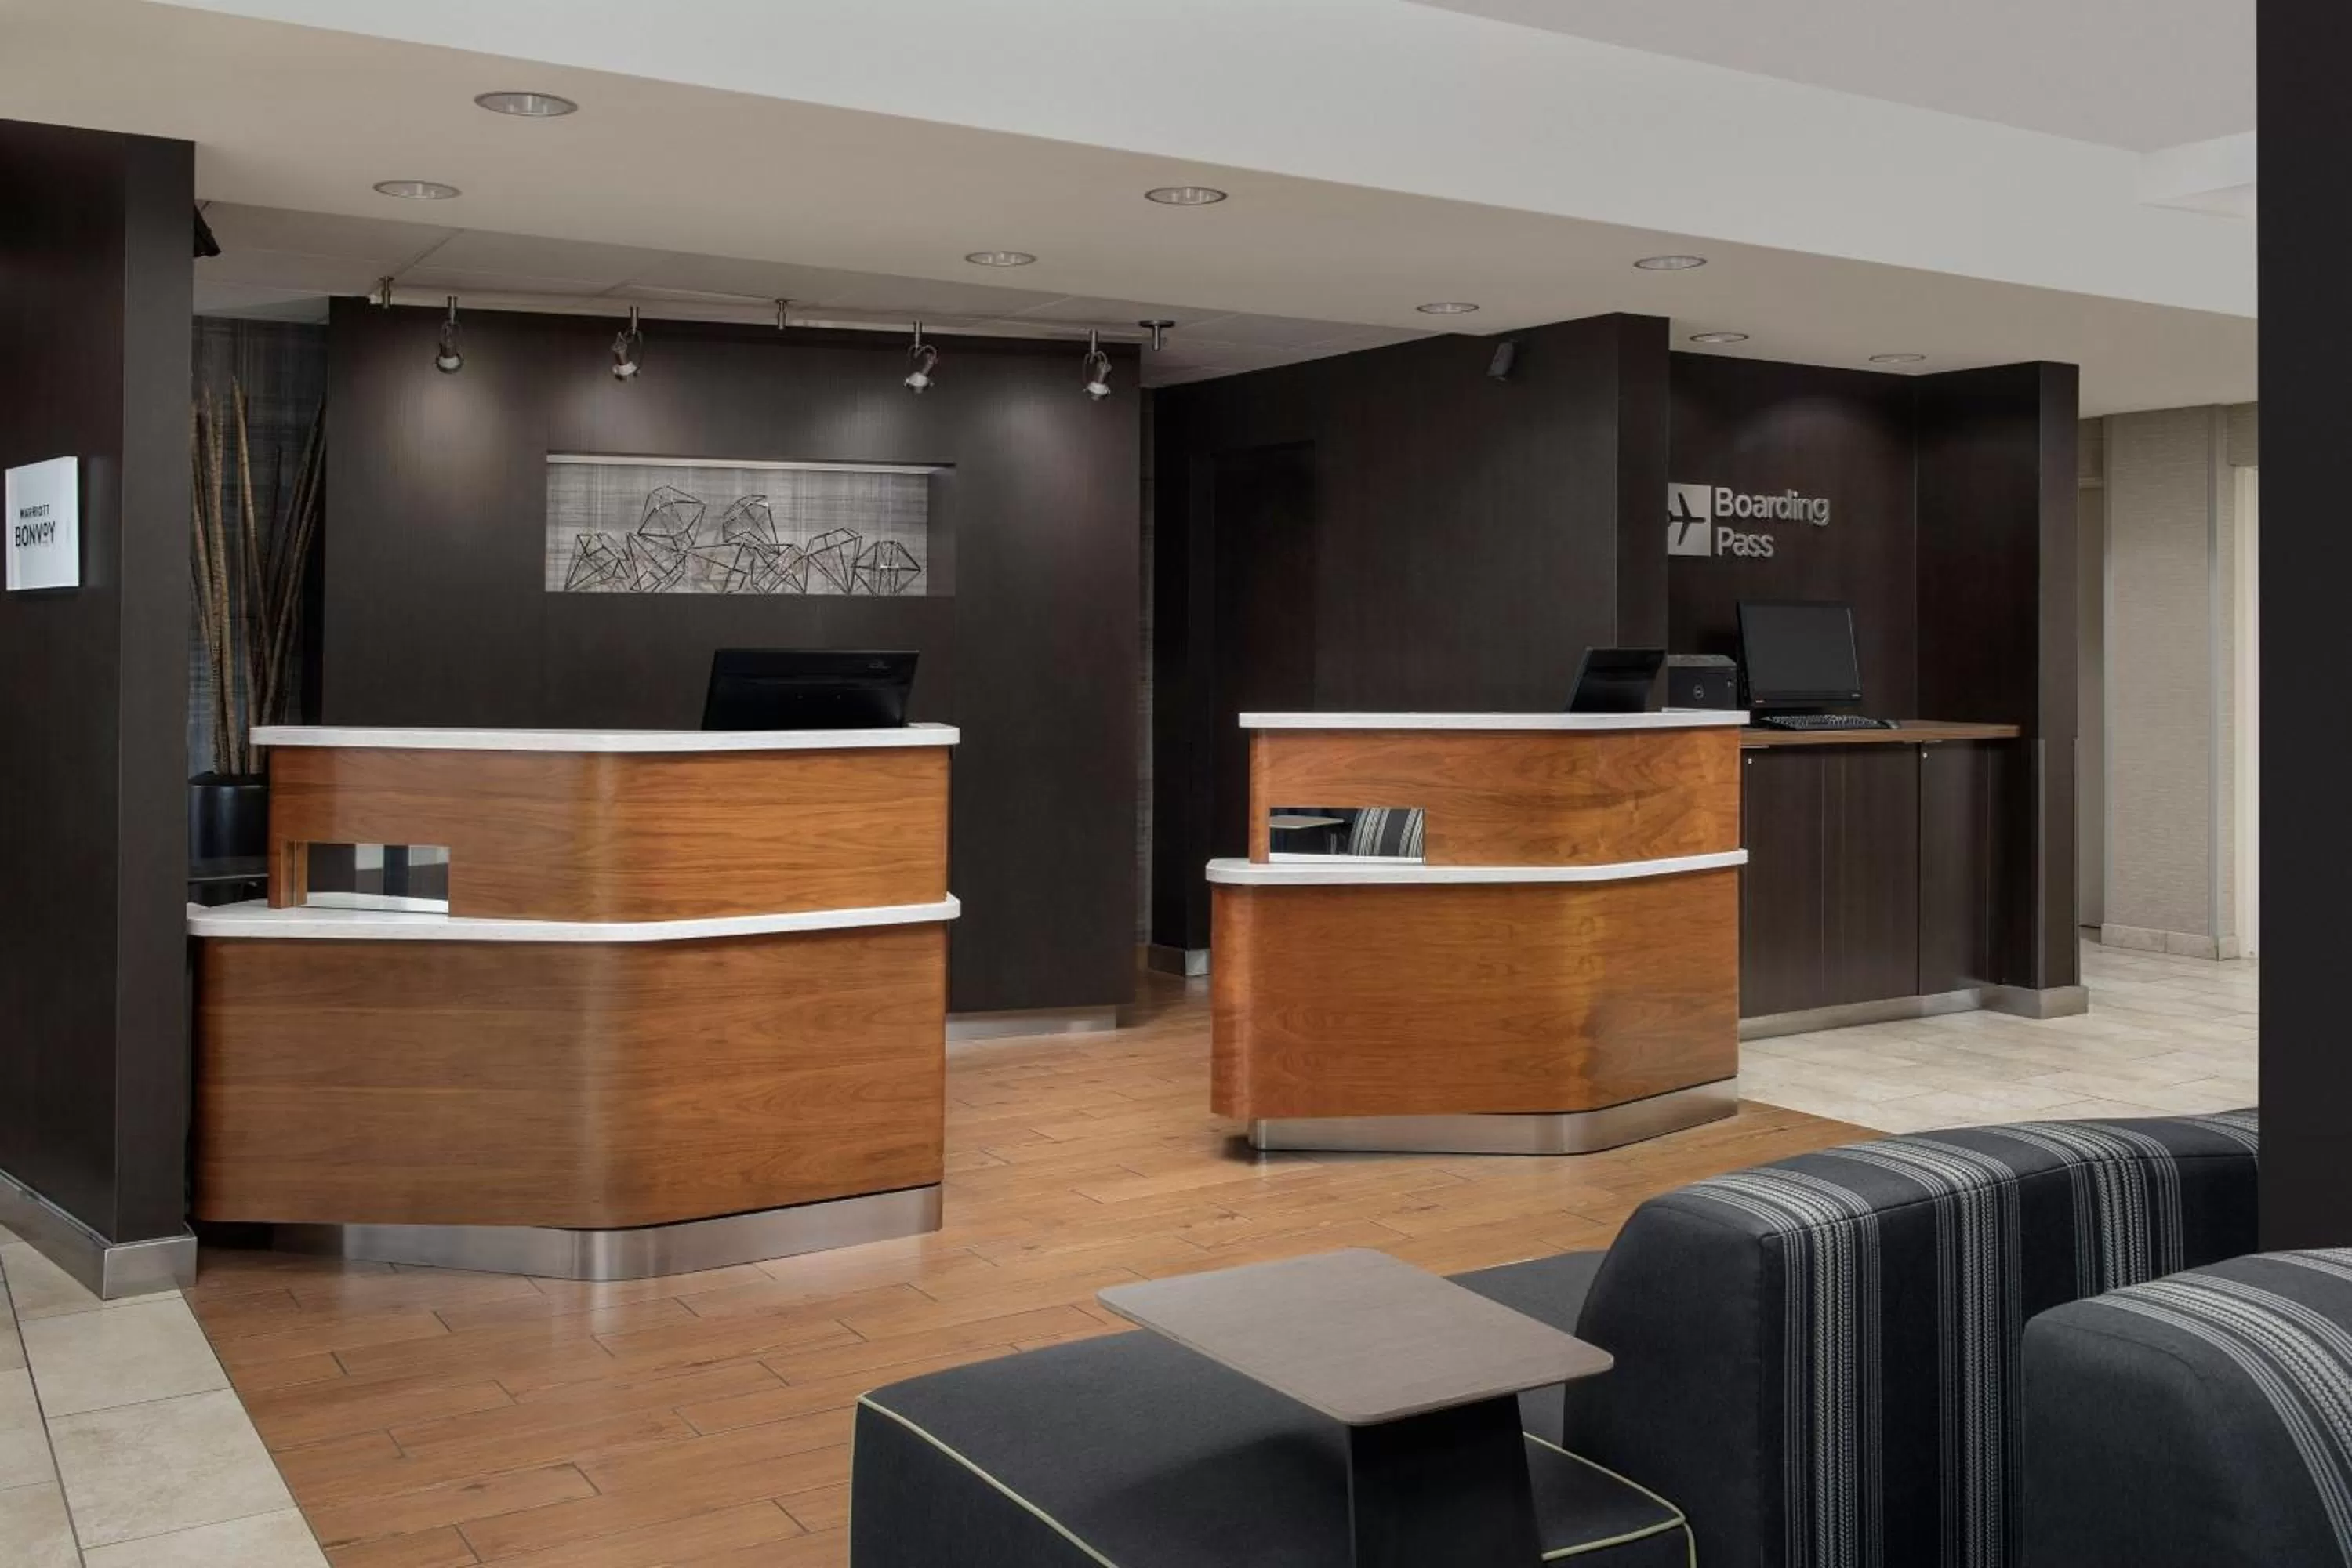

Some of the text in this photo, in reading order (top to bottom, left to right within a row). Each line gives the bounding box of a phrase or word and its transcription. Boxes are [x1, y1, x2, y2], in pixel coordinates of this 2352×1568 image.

[20, 504, 49, 518] MARRIOTT
[1715, 487, 1830, 526] Boarding
[15, 521, 55, 546] BONVOY
[1717, 526, 1774, 557] Pass
